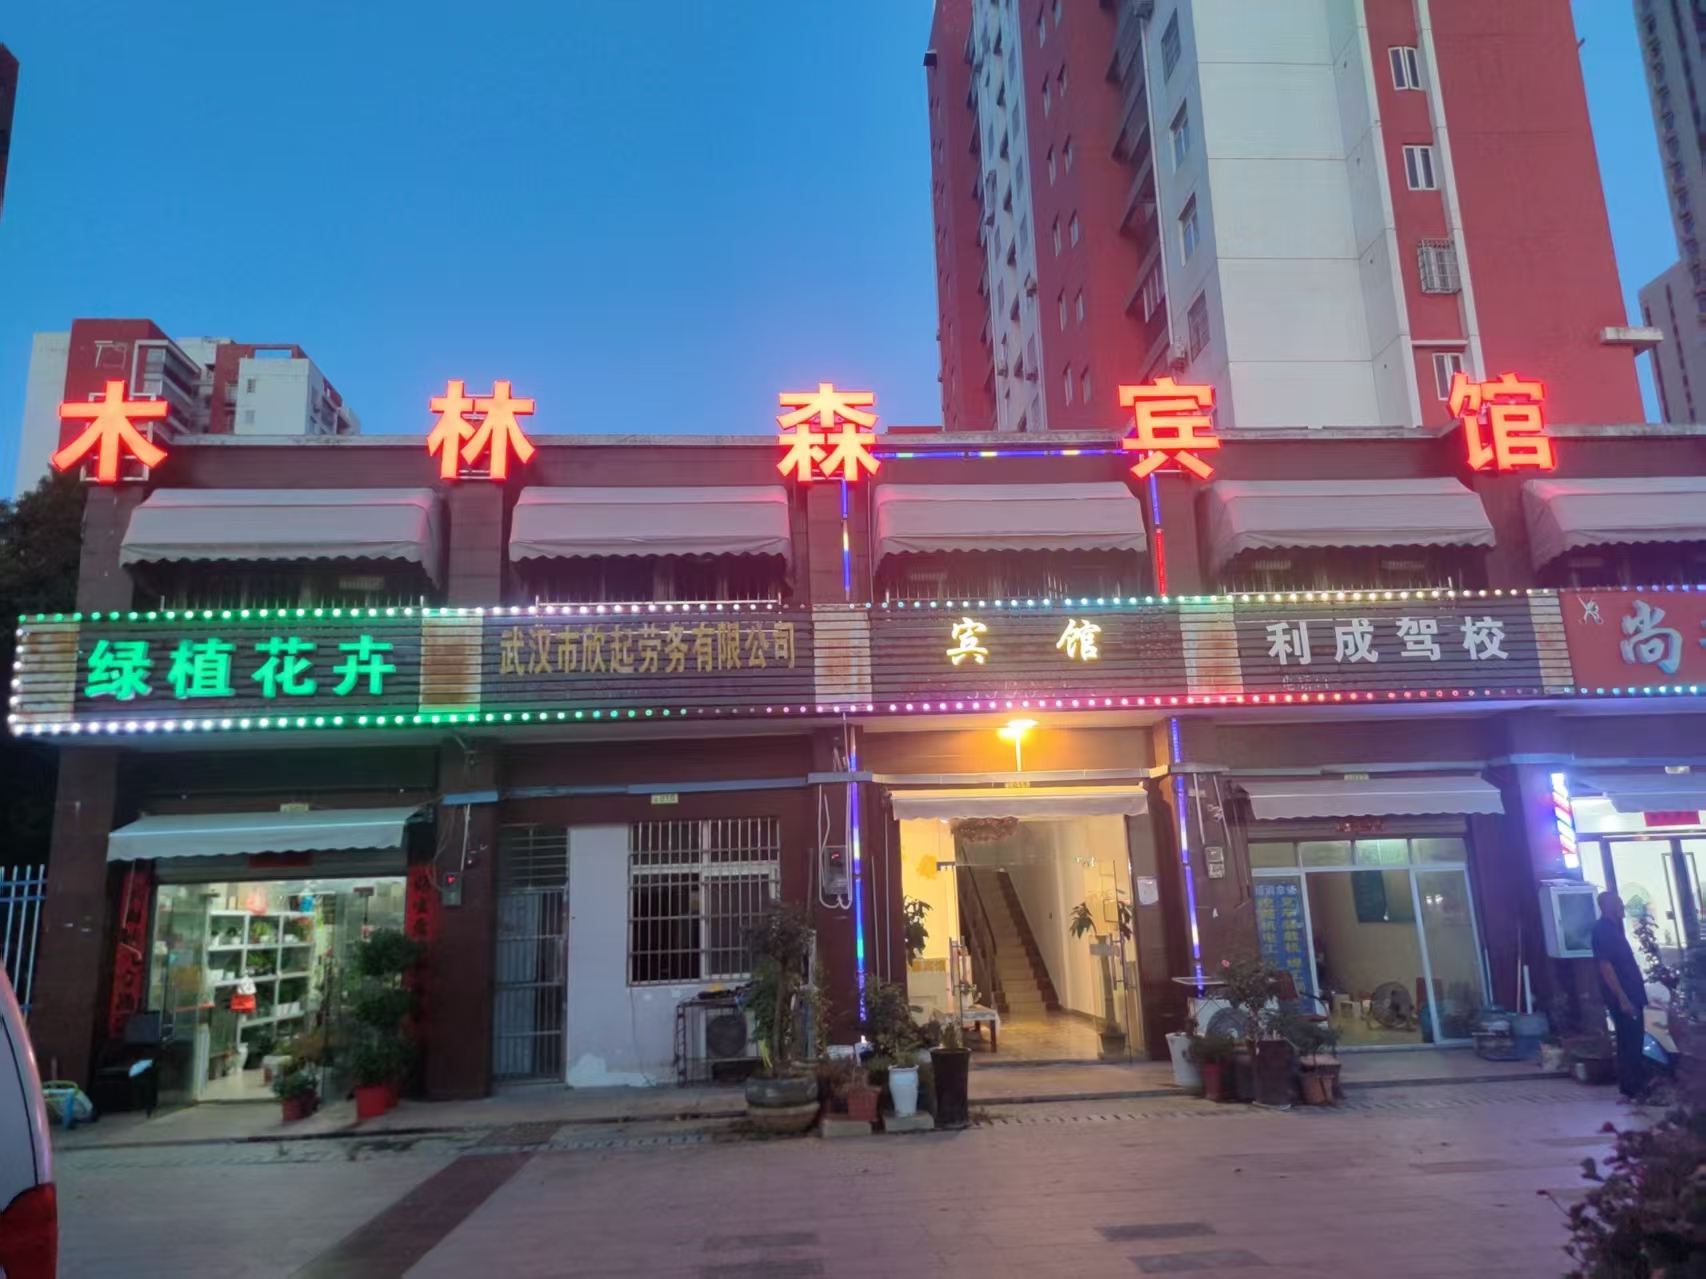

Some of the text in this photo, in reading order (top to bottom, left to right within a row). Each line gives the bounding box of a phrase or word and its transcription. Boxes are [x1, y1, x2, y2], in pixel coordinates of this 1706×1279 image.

[52, 377, 1556, 481] 木林森宾馆
[499, 621, 796, 677] 武汉市欣起劳务有限公司
[946, 616, 1102, 667] 宾馆
[1265, 616, 1509, 666] 利成驾校
[1619, 599, 1706, 675] 尚
[84, 636, 396, 700] 绿植花卉
